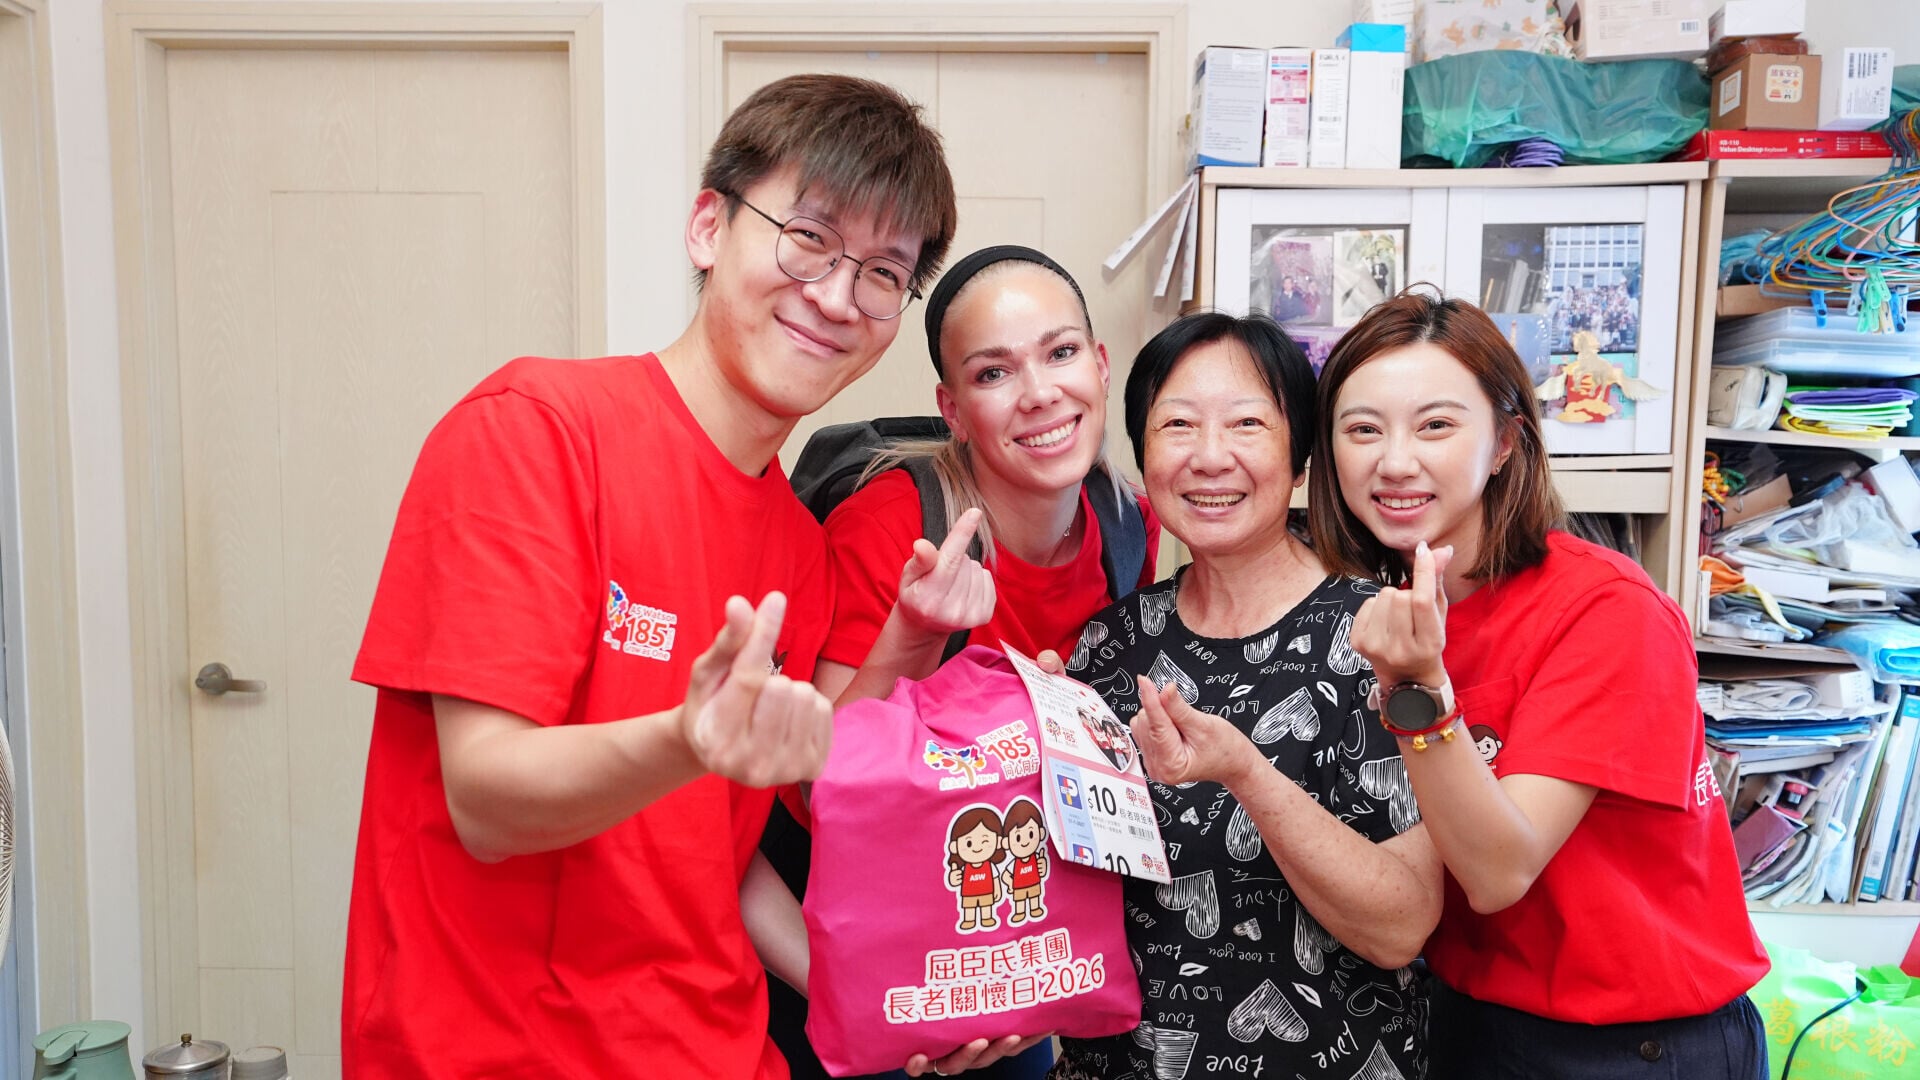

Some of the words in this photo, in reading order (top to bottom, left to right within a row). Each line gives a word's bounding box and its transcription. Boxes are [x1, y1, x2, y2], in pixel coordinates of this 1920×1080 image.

[1738, 146, 1764, 154] Desktop
[643, 606, 676, 622] Watson
[627, 617, 668, 648] 185
[651, 648, 669, 660] One
[986, 734, 1032, 762] 185
[969, 873, 986, 882] ASW
[1020, 865, 1033, 875] ASW
[928, 931, 1067, 981] 屈臣氏集團
[887, 958, 1103, 1020] 長者關懷日2026
[1148, 979, 1223, 1002] LOVE
[1760, 996, 1917, 1068] 葛根粉
[1206, 1054, 1265, 1080] Love
